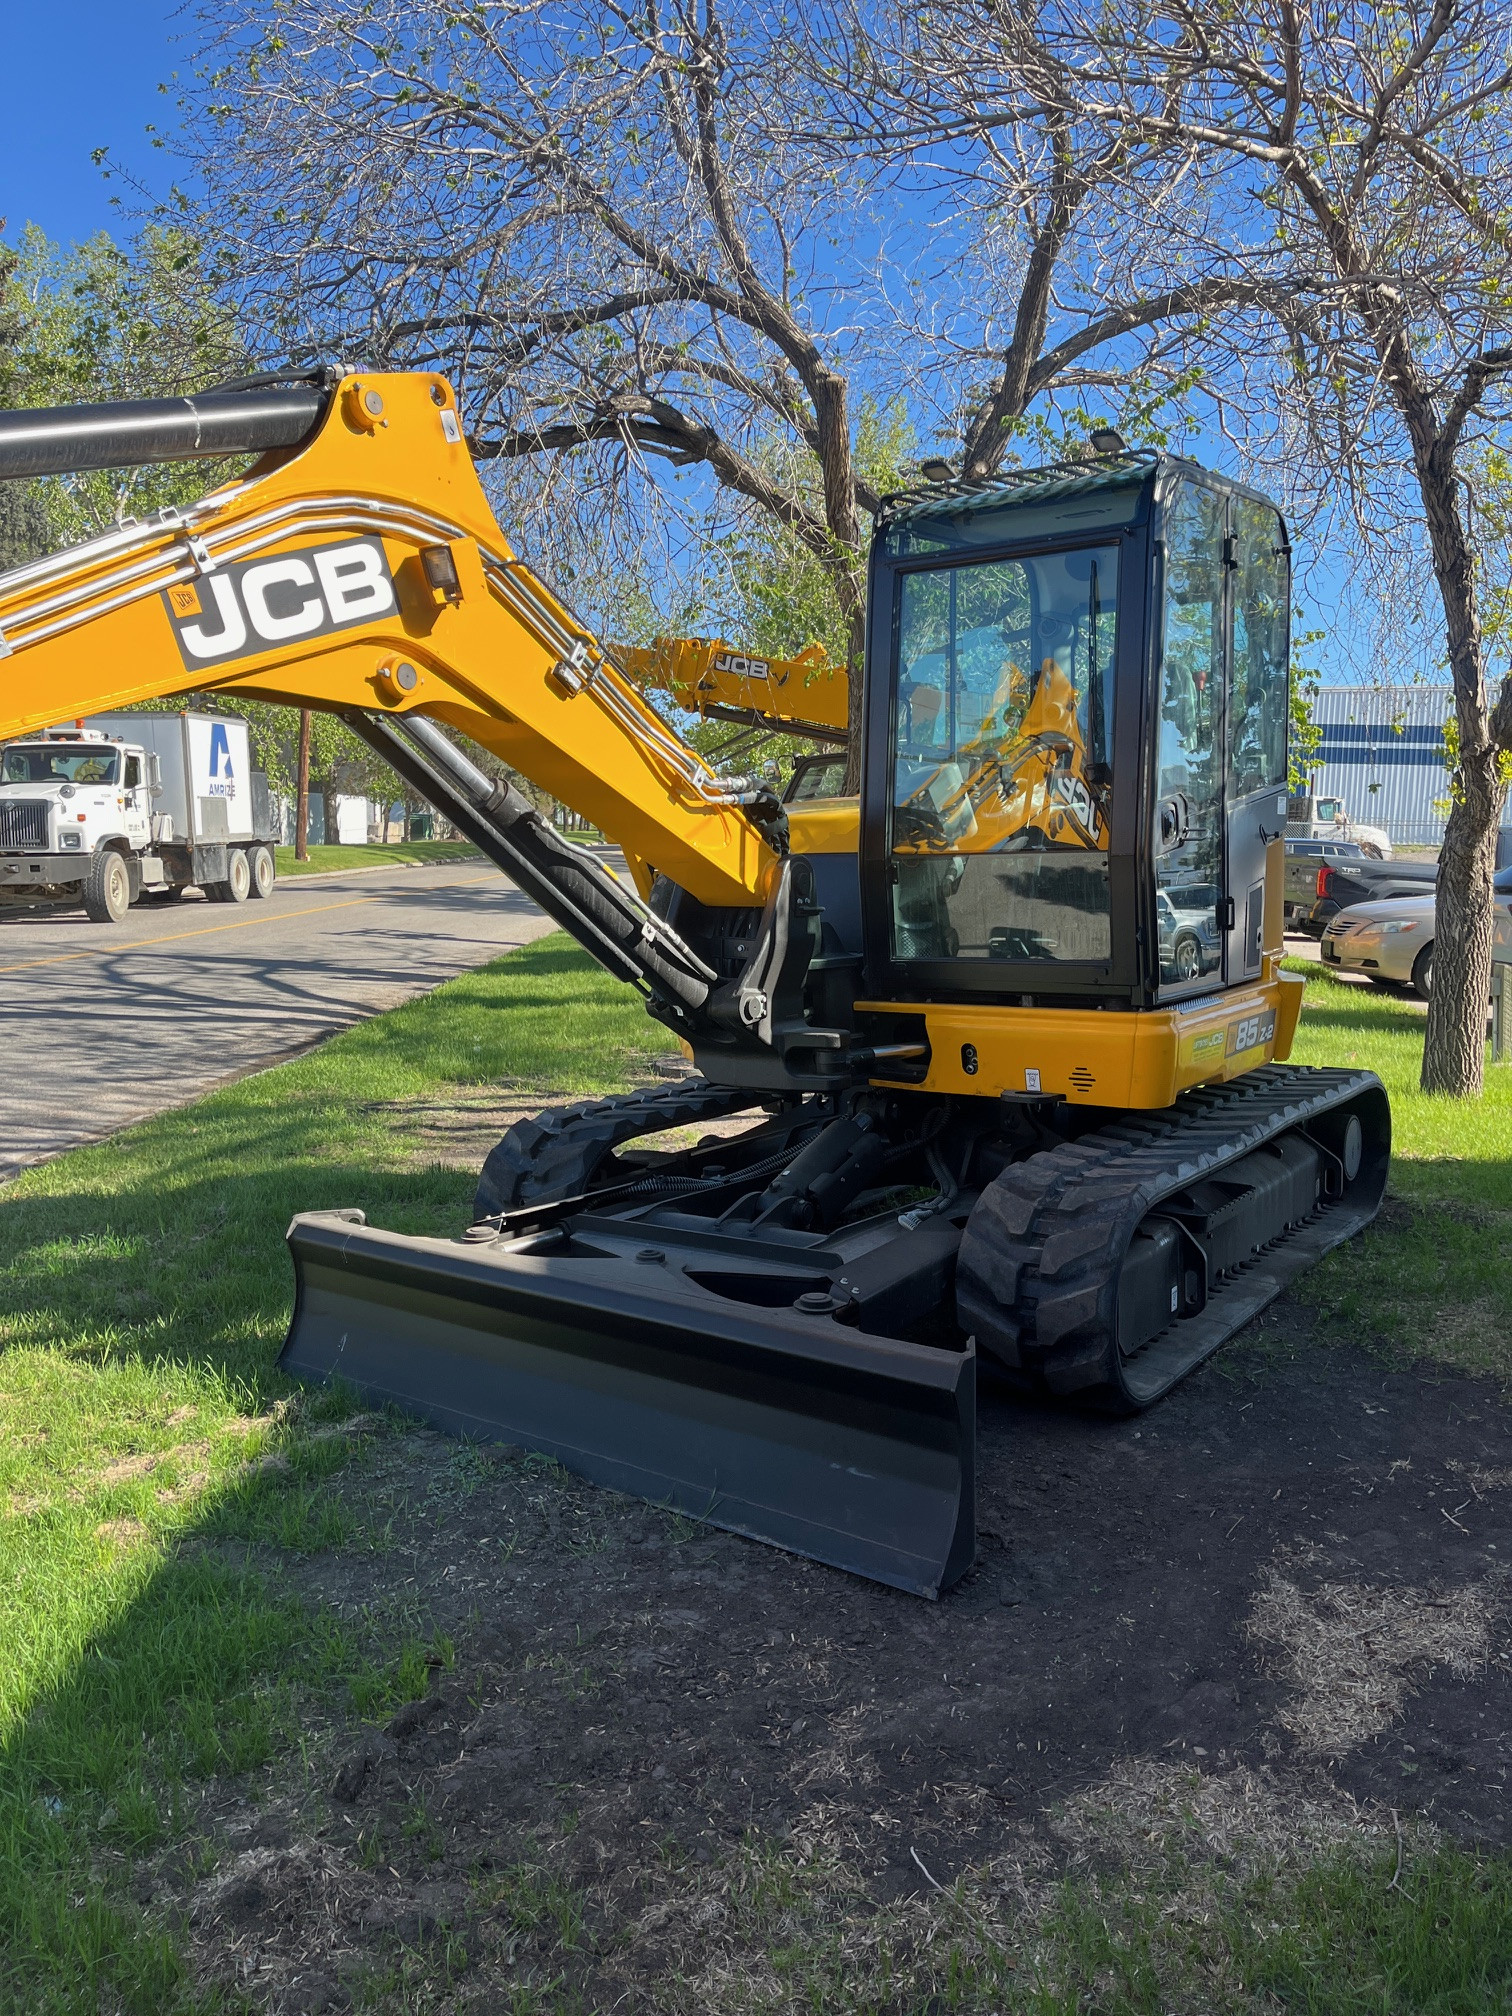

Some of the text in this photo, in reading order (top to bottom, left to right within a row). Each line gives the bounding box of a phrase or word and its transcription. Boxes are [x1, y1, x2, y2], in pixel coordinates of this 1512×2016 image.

[175, 592, 194, 608] JCB
[180, 543, 394, 658] JCB
[715, 655, 768, 679] JCB
[208, 783, 236, 797] AMRIZE
[1208, 1033, 1223, 1047] JCB
[1236, 1017, 1259, 1051] 85
